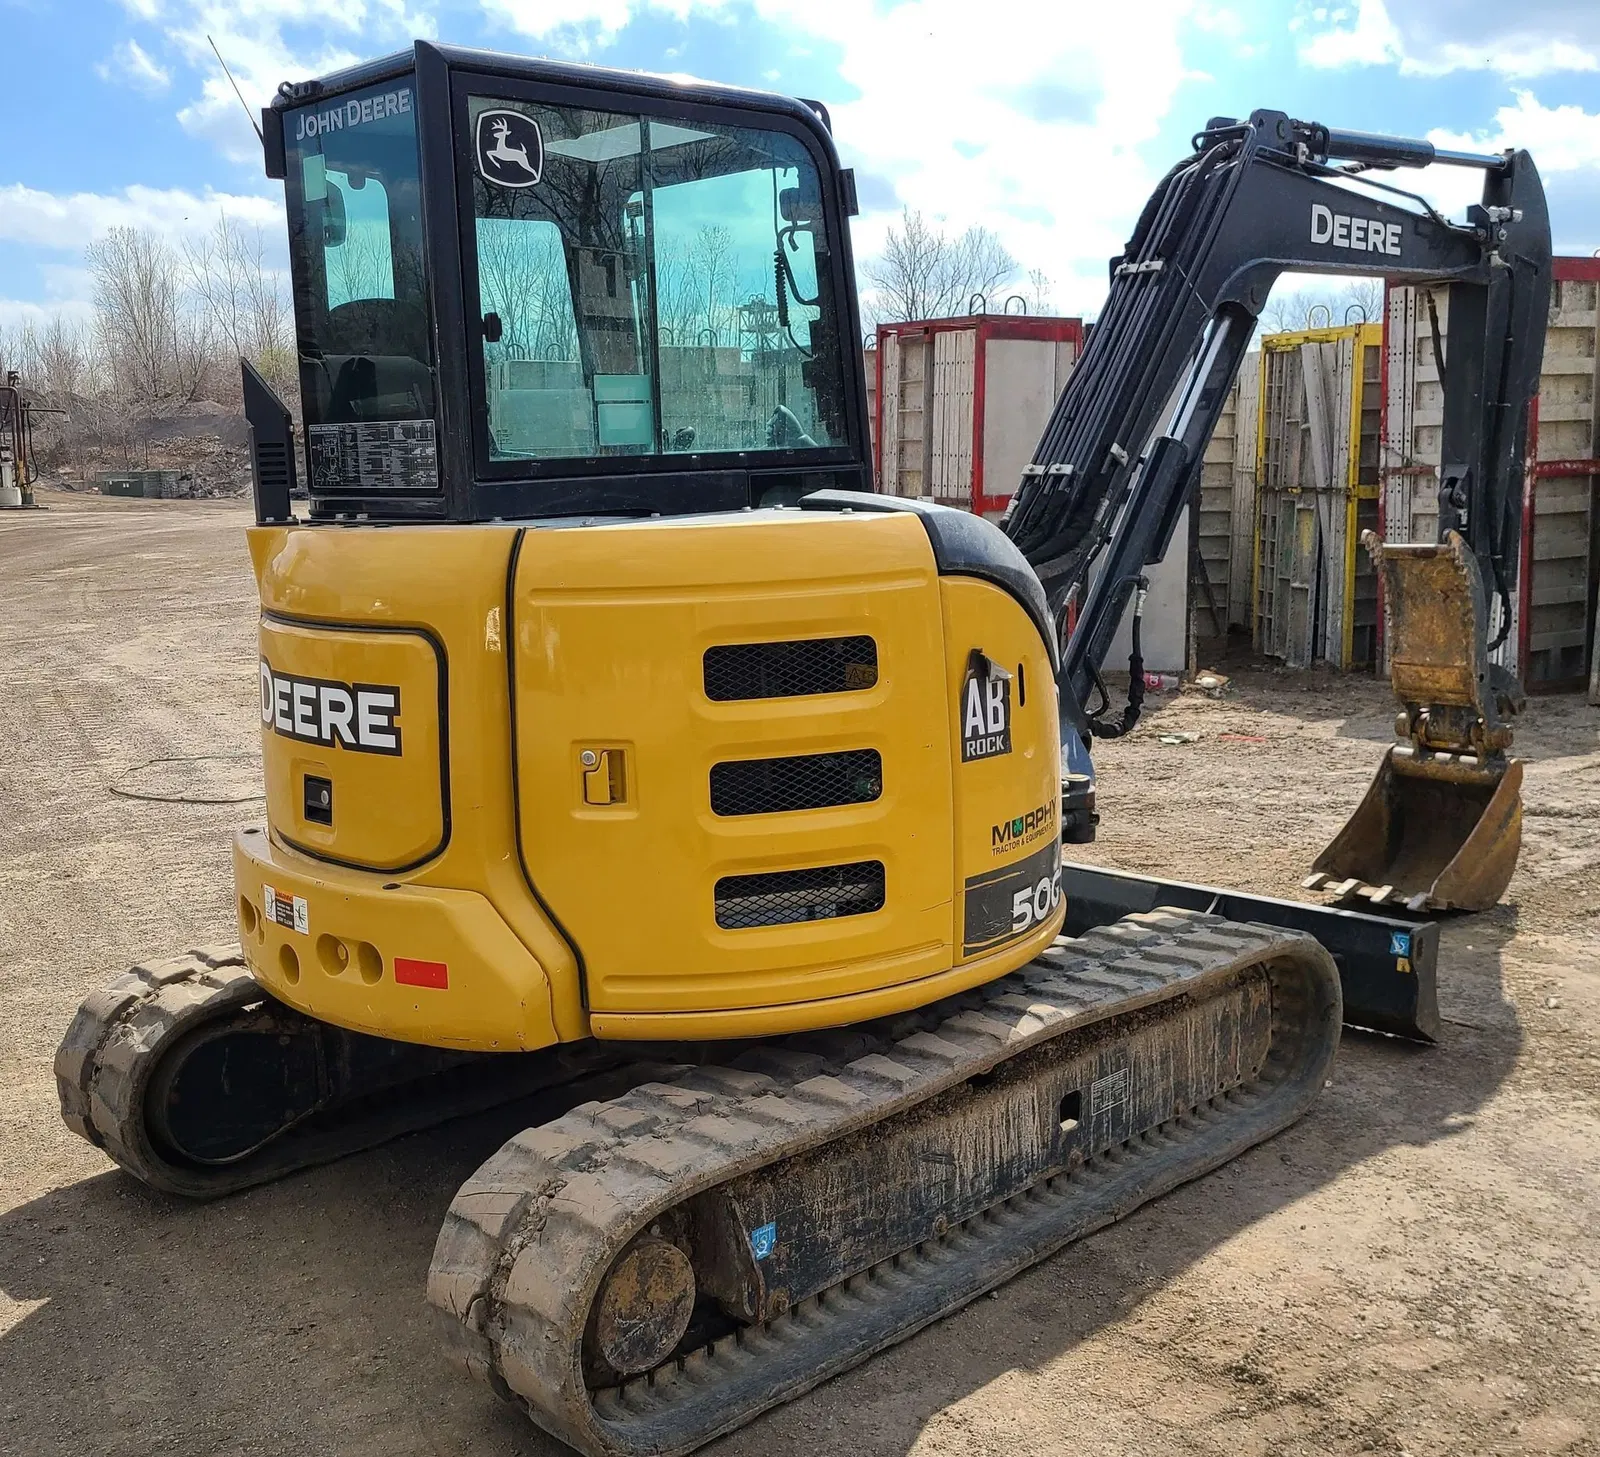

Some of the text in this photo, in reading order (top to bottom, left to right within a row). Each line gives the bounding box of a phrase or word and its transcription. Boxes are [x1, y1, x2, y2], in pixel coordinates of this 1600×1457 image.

[296, 88, 411, 141] JOHN DEERE
[1310, 203, 1402, 256] DEERE
[260, 660, 397, 749] DEERE
[964, 676, 1006, 739] AB
[966, 734, 1005, 757] ROCK
[991, 839, 1020, 857] TRACTOR
[992, 797, 1056, 846] MURPHY
[1012, 868, 1061, 934] 50G
